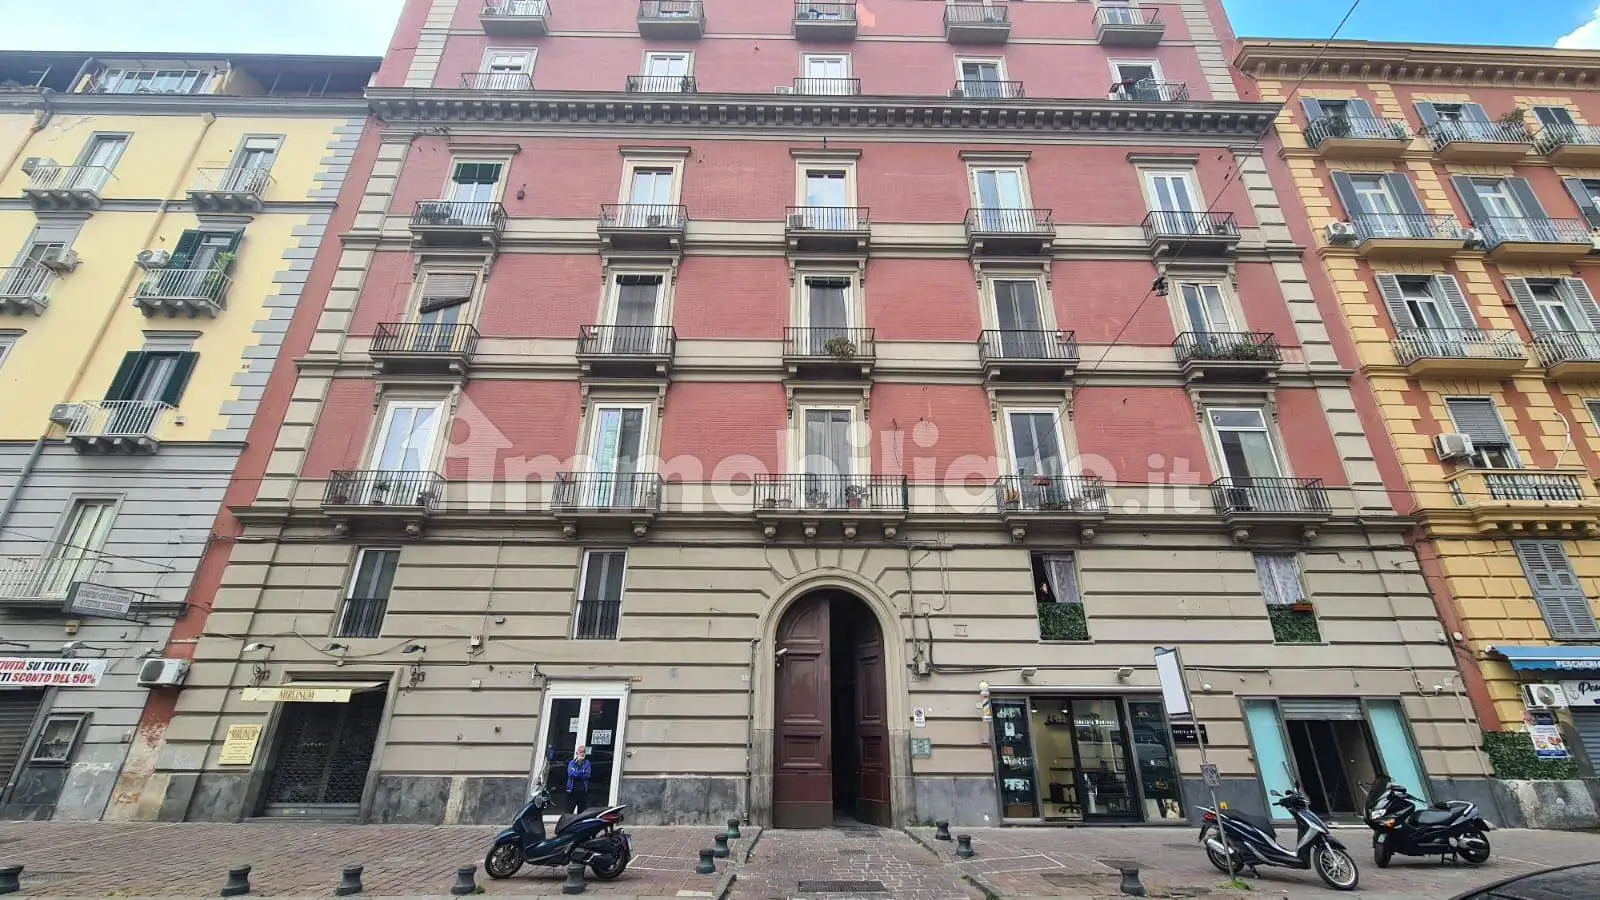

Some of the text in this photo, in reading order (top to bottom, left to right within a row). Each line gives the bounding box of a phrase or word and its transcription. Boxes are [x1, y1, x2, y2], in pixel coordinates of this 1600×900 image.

[26, 661, 41, 671] SU
[42, 661, 70, 671] TUTTI
[71, 662, 89, 671] GLI
[12, 672, 51, 683] SCONTO
[52, 673, 70, 683] DEL
[72, 673, 96, 684] 50%
